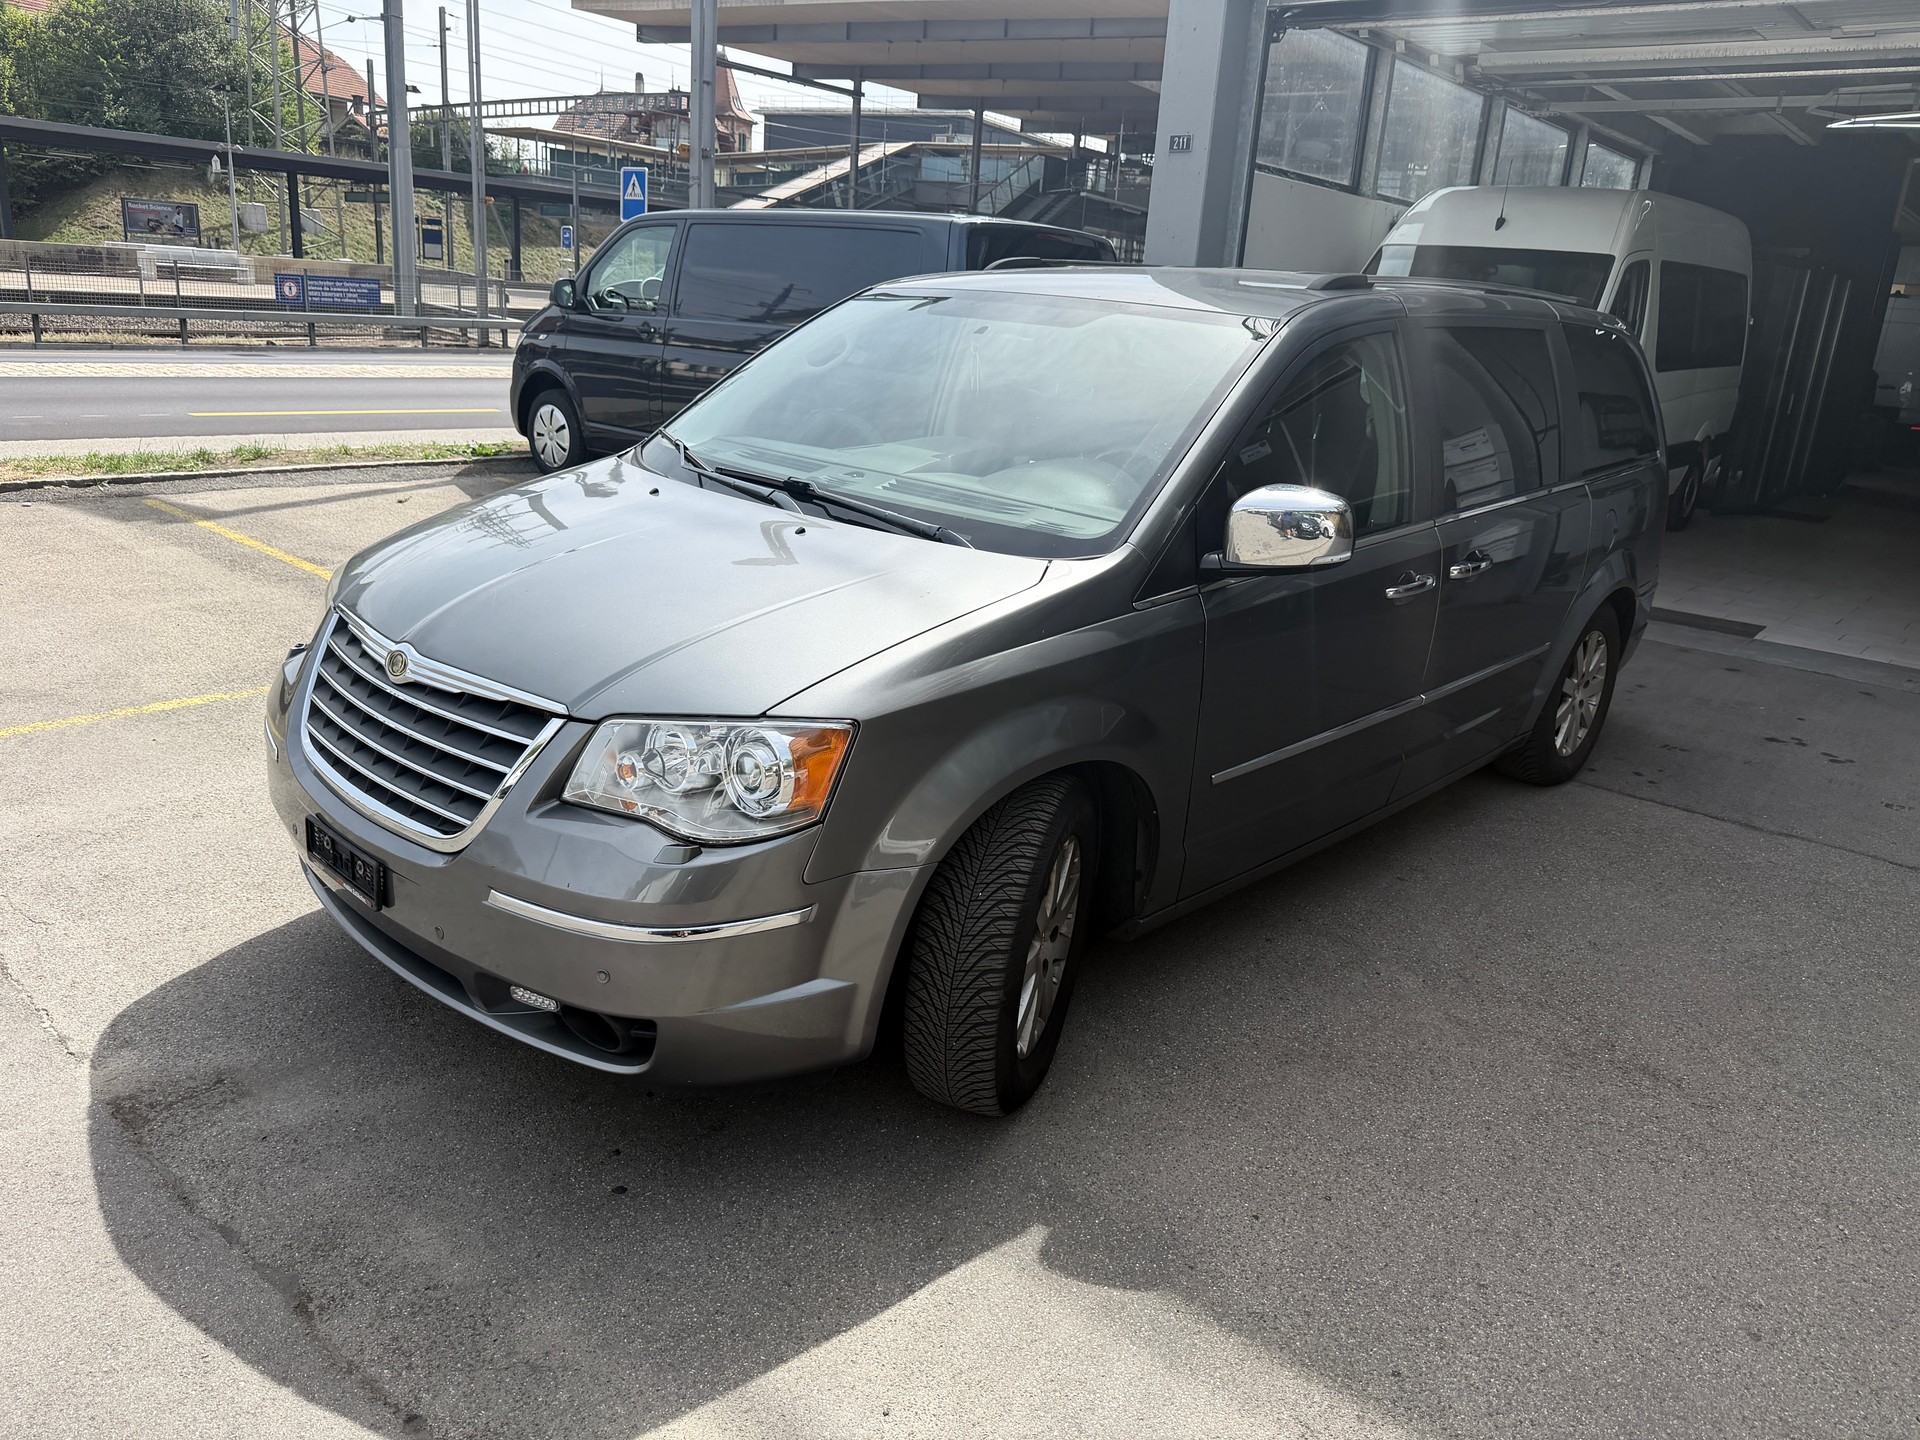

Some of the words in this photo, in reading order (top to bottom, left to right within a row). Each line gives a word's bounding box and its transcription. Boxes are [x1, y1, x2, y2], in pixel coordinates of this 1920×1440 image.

[1173, 137, 1187, 149] 211
[128, 202, 149, 210] Rocket
[150, 203, 173, 211] Science.
